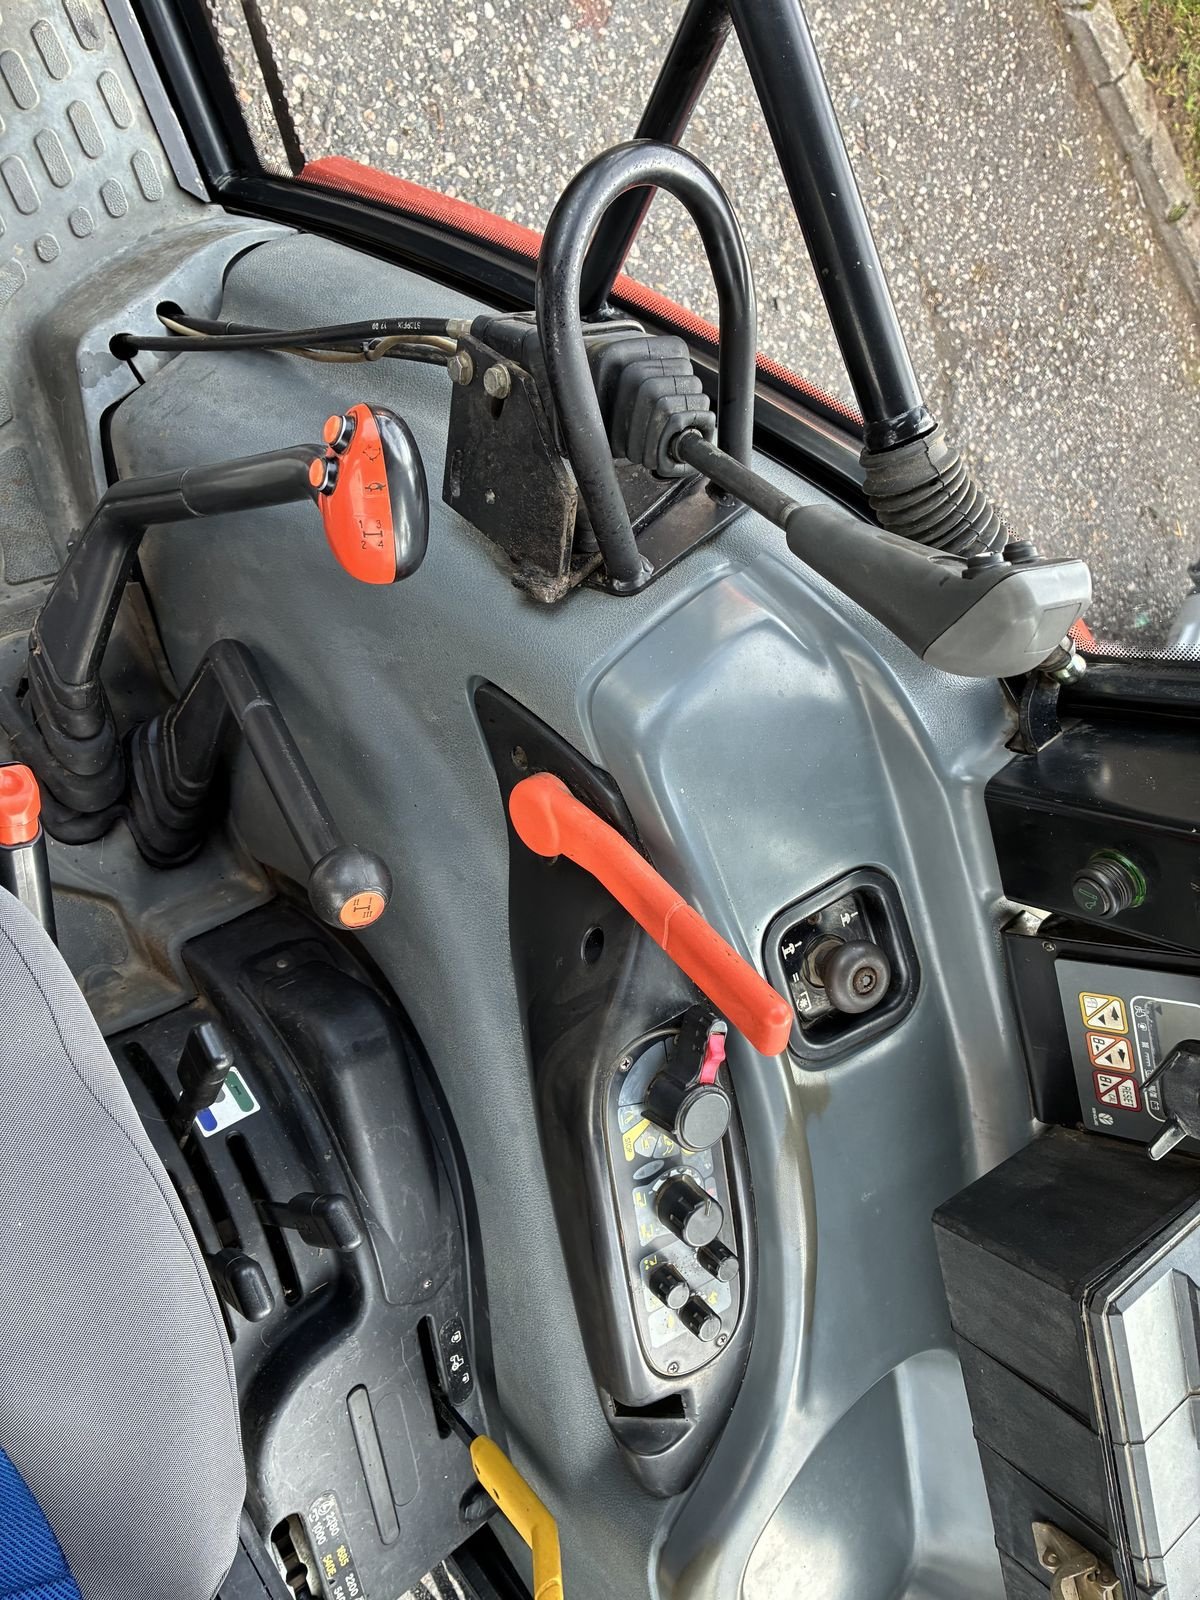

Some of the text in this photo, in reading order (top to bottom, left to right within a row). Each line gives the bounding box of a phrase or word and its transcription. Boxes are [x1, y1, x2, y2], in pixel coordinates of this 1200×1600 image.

[376, 520, 382, 528] 3
[361, 540, 384, 549] 2 4
[1122, 1085, 1134, 1106] RESET
[313, 1521, 327, 1545] 1000
[322, 1553, 337, 1577] 540E
[345, 1572, 360, 1597] 2200
